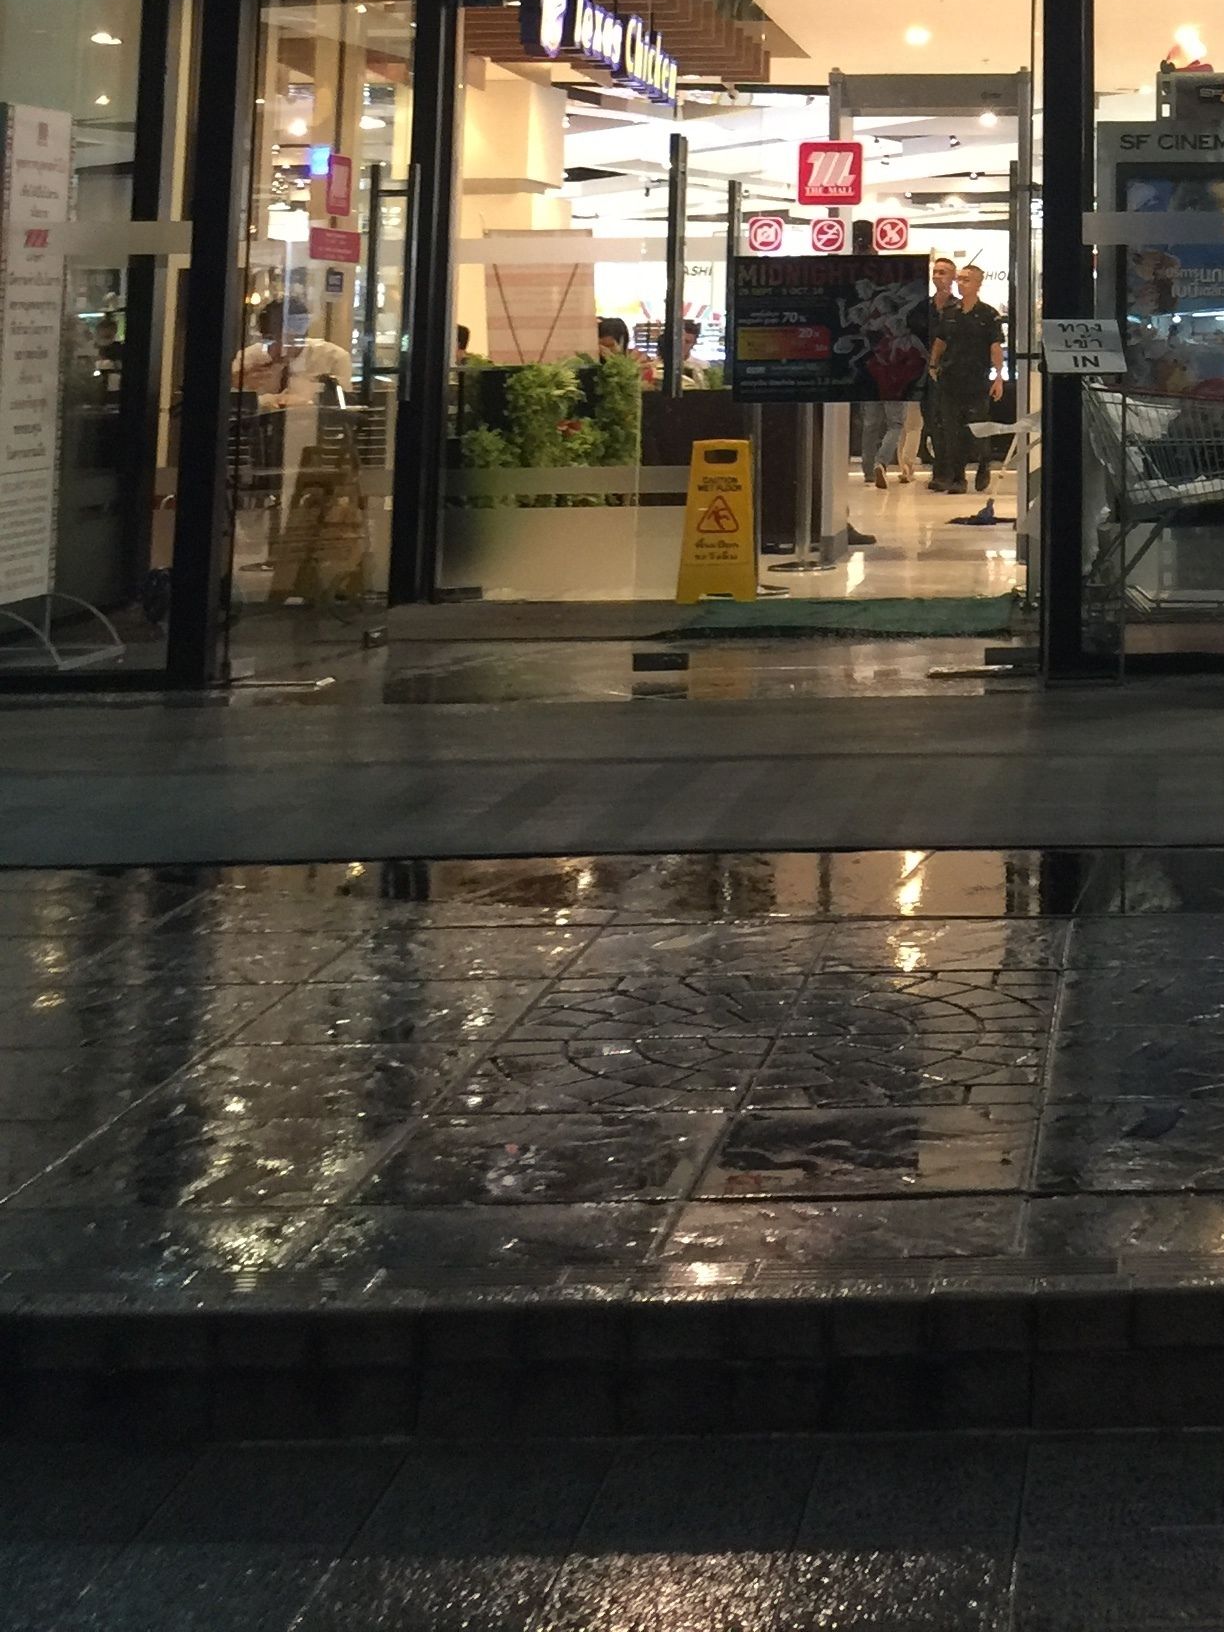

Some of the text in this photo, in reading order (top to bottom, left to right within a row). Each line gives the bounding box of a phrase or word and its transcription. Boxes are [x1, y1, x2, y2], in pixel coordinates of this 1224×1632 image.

[626, 16, 678, 102] Chicken
[1119, 134, 1151, 151] SF
[804, 187, 855, 197] THE MALL
[736, 263, 860, 287] MIDNIGHT
[1058, 322, 1102, 334] ทาง
[1065, 334, 1103, 349] เข้า
[1072, 355, 1100, 368] IN
[703, 476, 738, 484] CAUTION
[697, 483, 742, 491] WET FLOOR
